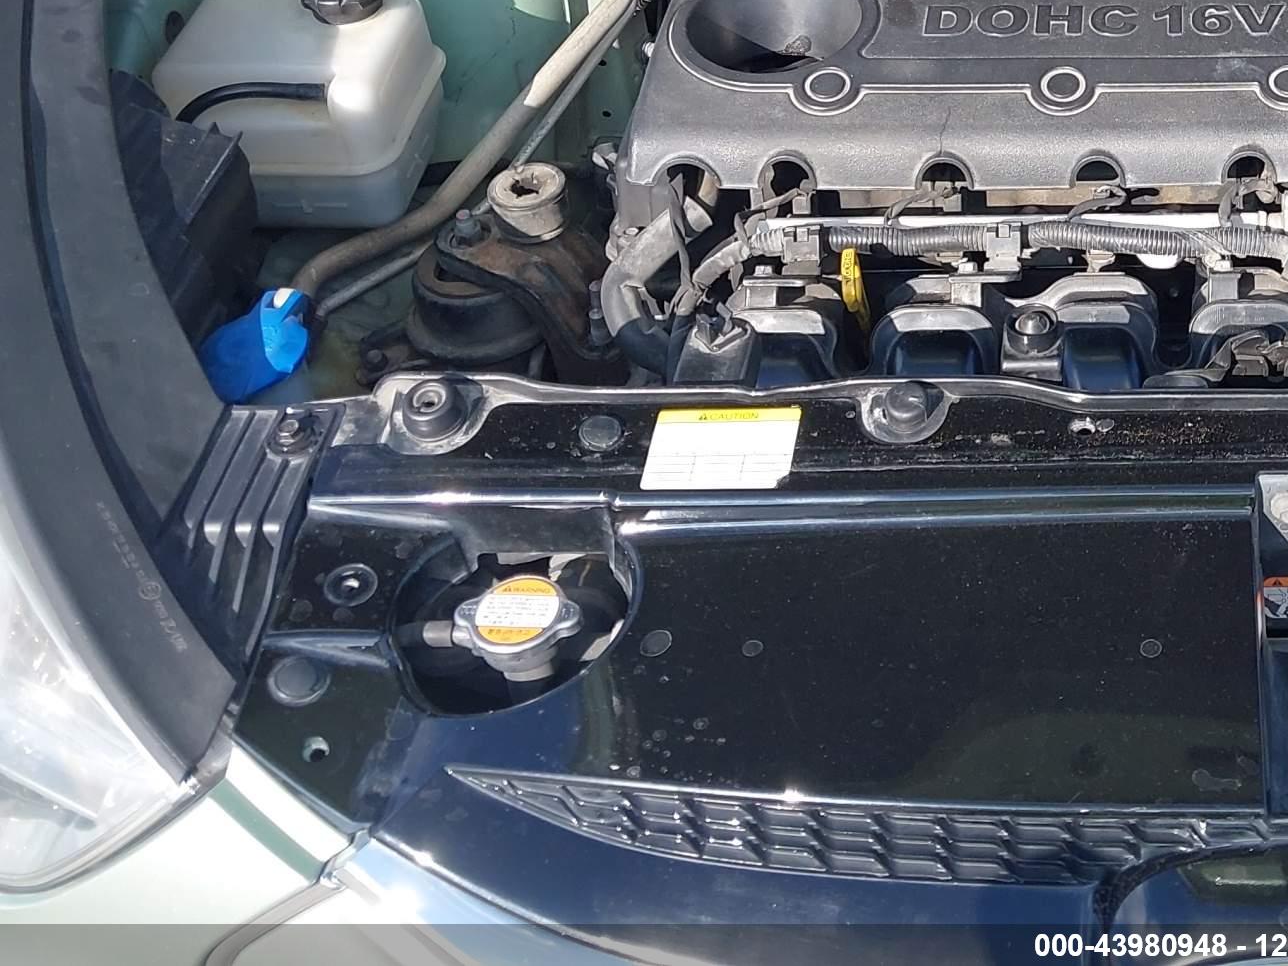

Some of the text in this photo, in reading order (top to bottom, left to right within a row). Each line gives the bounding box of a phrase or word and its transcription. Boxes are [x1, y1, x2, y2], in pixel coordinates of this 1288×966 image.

[922, 3, 1288, 38] DOHC 16V
[709, 411, 760, 421] CAUTION
